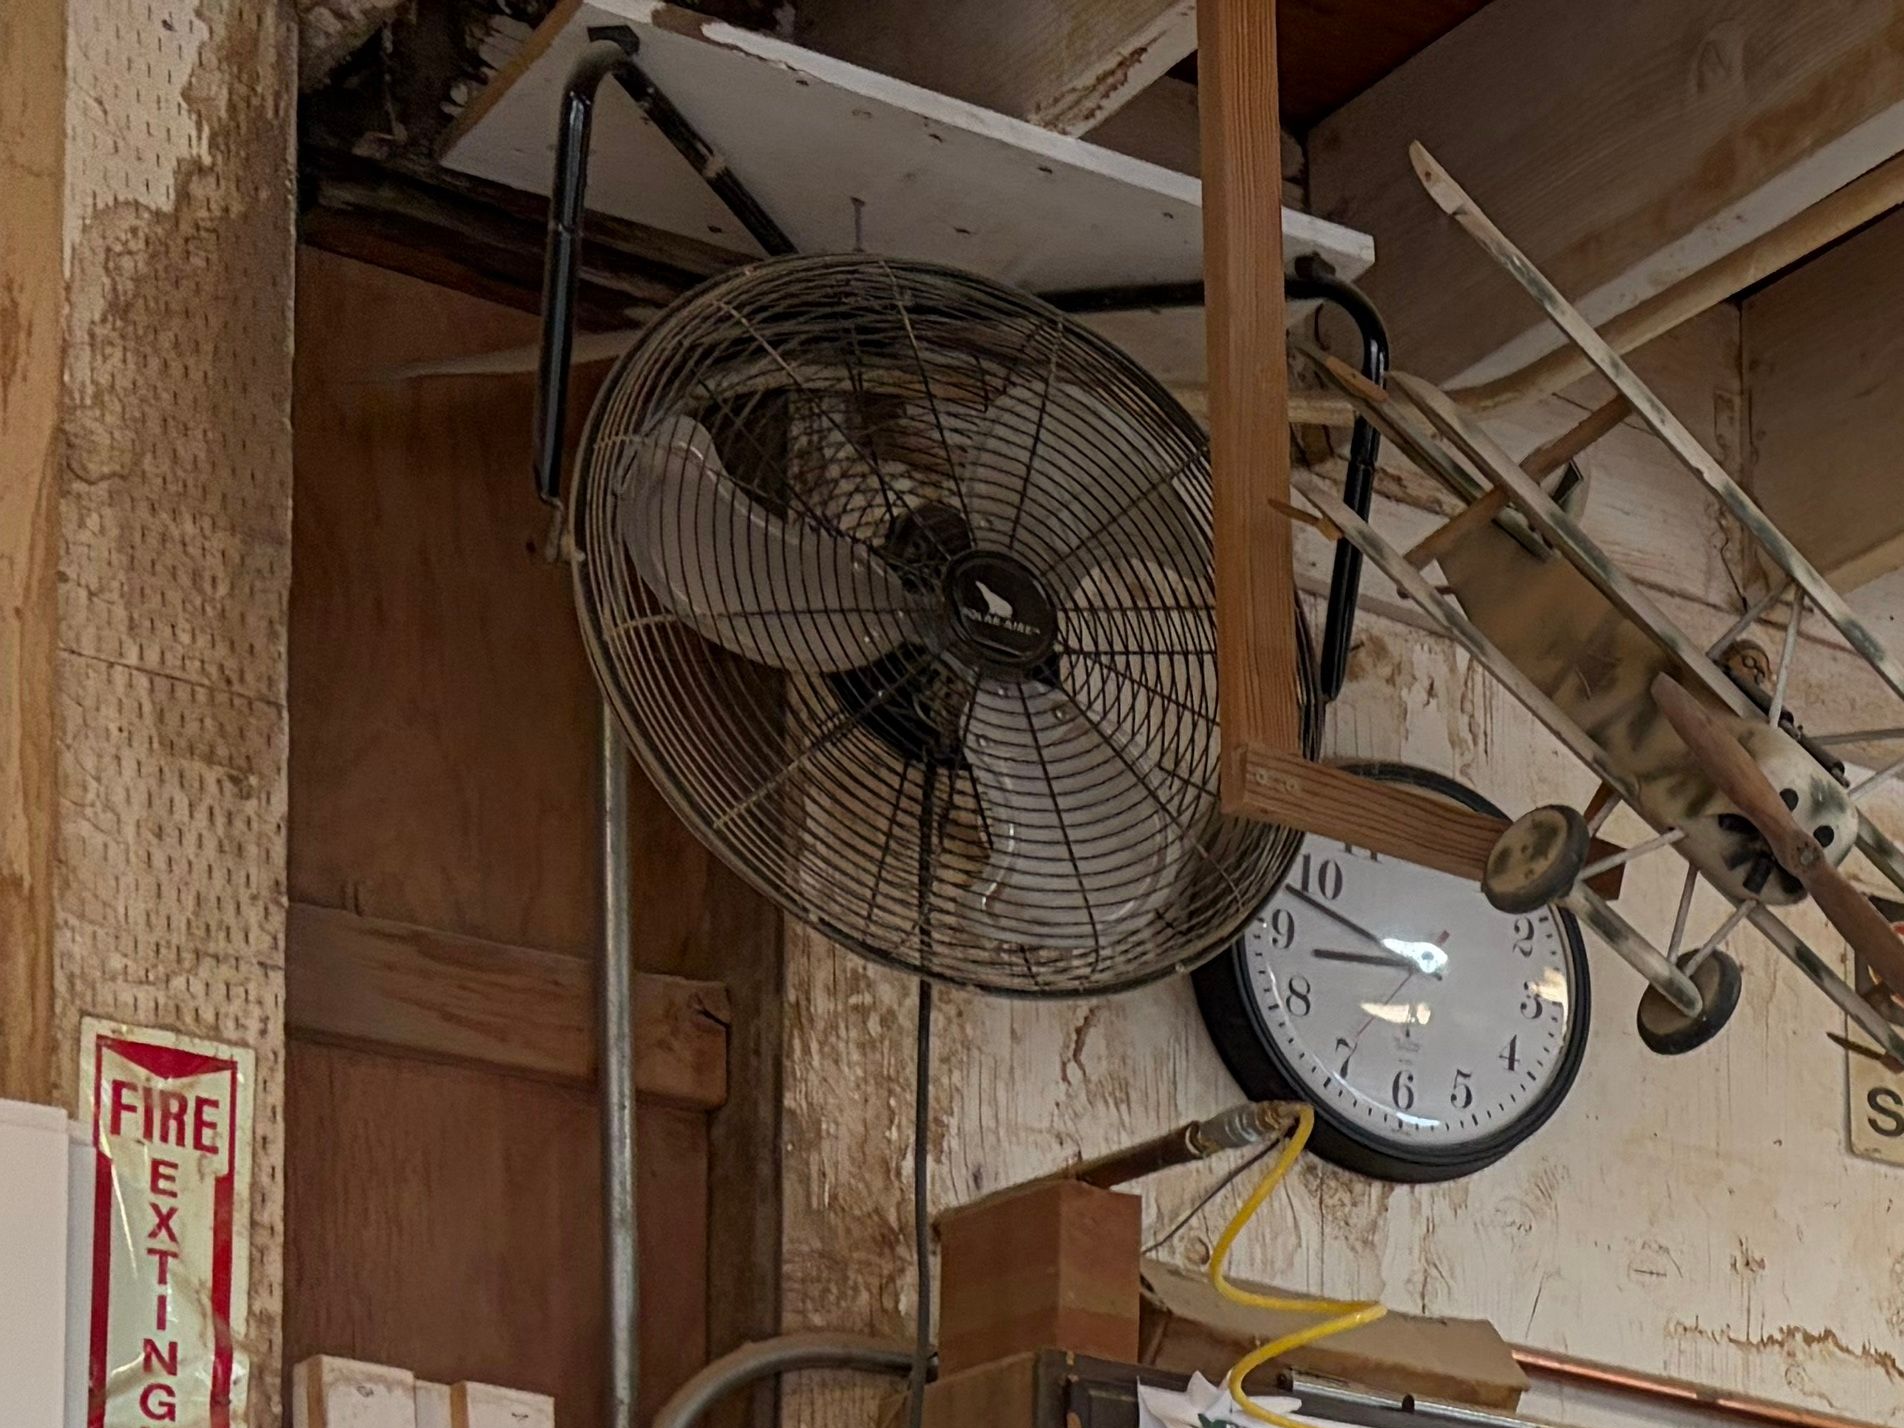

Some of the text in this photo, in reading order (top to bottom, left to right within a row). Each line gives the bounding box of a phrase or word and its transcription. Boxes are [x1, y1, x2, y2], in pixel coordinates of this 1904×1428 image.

[1301, 853, 1343, 900] 10
[1272, 909, 1295, 949] 9
[1513, 917, 1534, 957] 2
[1286, 975, 1311, 1017] 8
[1335, 1037, 1357, 1078] 7
[1499, 1034, 1520, 1072] 4
[1392, 1070, 1414, 1111] 6
[1451, 1069, 1473, 1110] 5
[110, 1078, 220, 1156] FIRE
